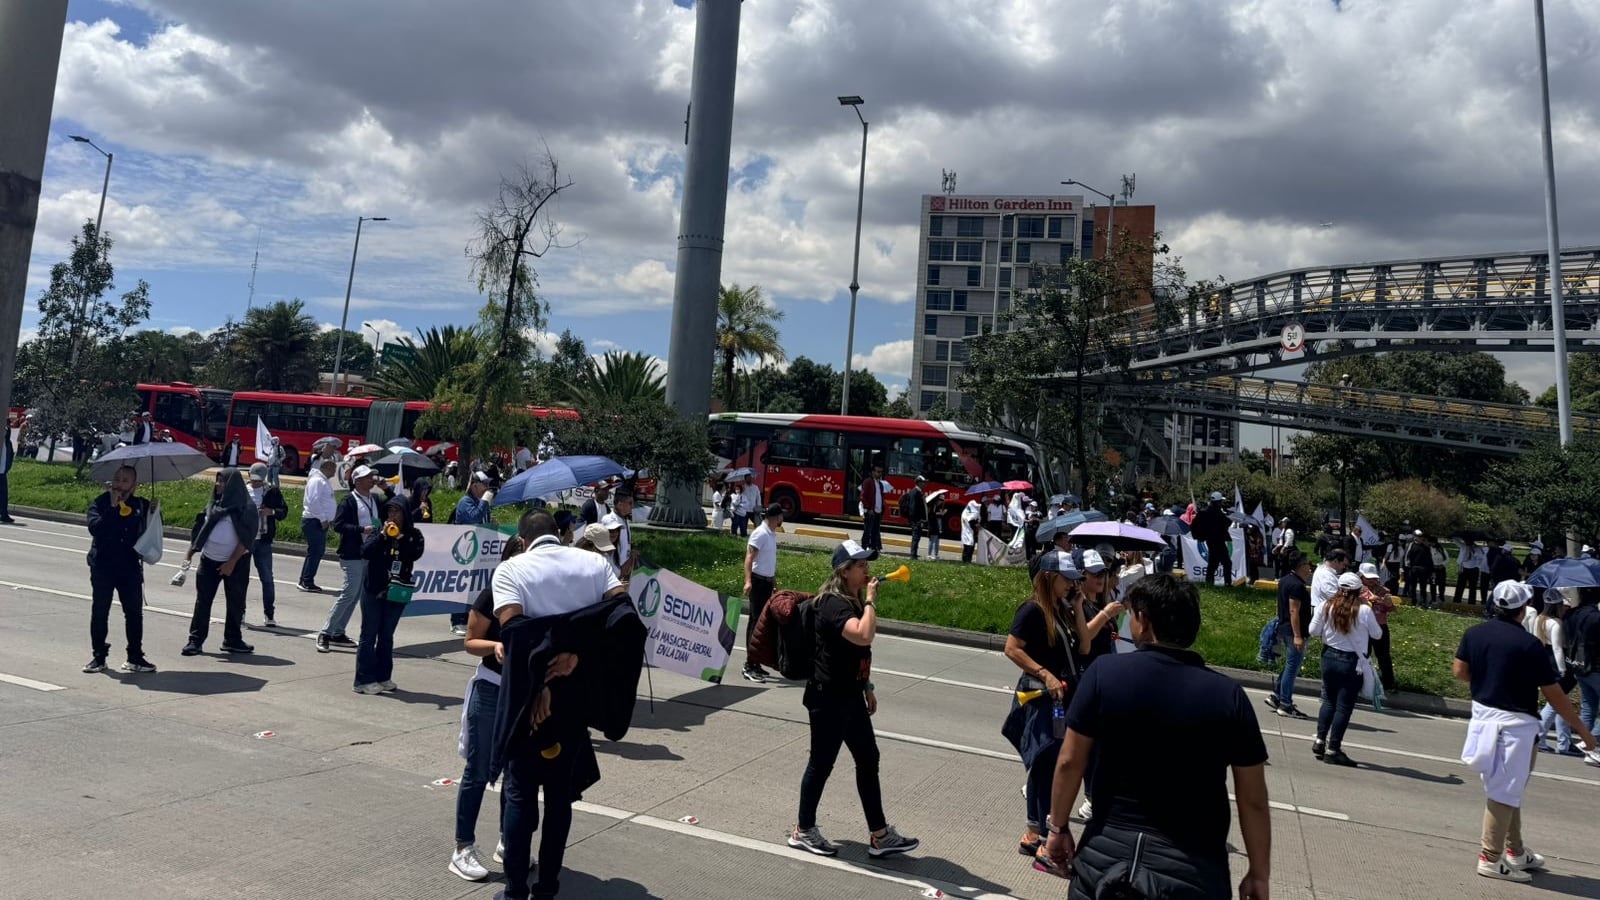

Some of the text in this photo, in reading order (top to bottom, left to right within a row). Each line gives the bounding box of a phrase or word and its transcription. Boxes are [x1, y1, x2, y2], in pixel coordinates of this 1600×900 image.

[949, 198, 1073, 211] Hilton Garden Inn
[412, 568, 497, 593] DIRECTIV
[663, 594, 714, 628] SEDIAN
[650, 627, 661, 641] LA
[660, 630, 690, 650] MASACRE
[656, 643, 667, 656] EN
